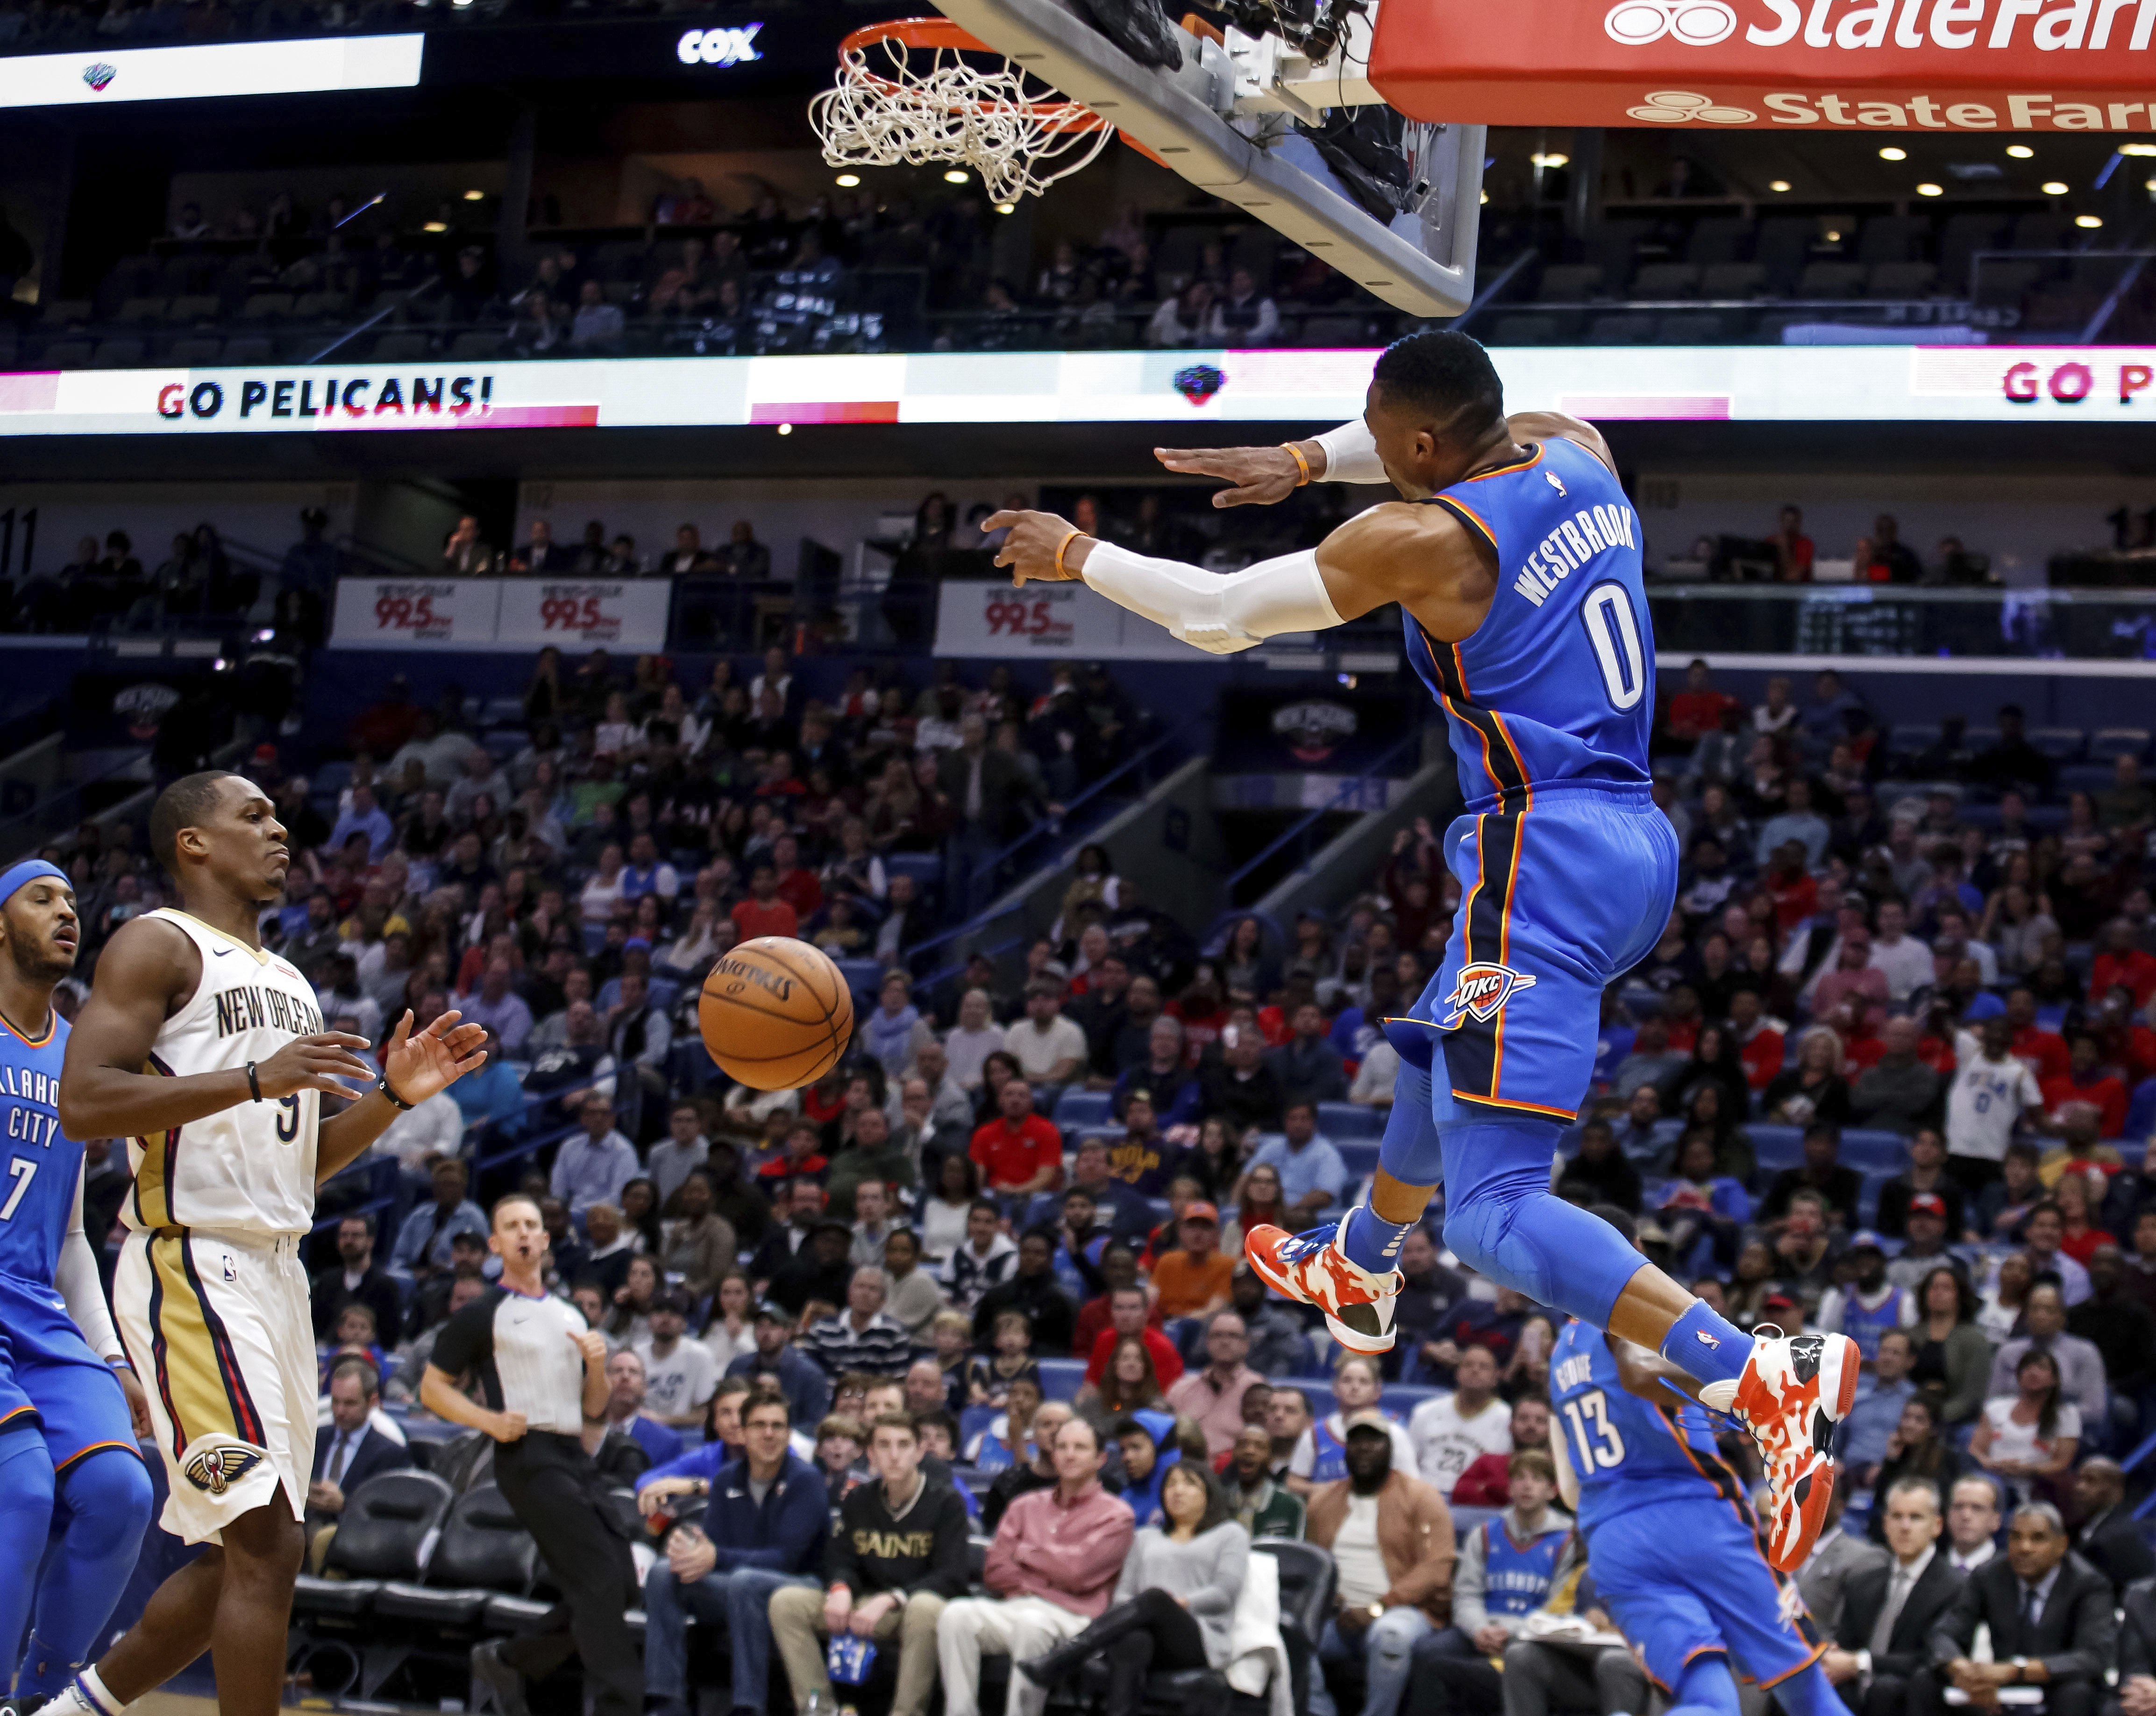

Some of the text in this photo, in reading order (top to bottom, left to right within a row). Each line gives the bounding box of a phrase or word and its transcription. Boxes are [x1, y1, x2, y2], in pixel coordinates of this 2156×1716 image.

[677, 22, 763, 68] COX
[1763, 93, 2156, 130] State Far
[157, 376, 494, 420] GO PELICANS!
[2003, 362, 2094, 404] GO
[1513, 503, 1635, 607] WESTBROOK
[1581, 580, 1645, 712] 0
[214, 986, 264, 1039] NEW
[1457, 974, 1501, 1008] OKC
[0, 1064, 59, 1108] LAHO
[8, 1106, 60, 1149] CITY
[0, 1155, 39, 1221] 7
[1563, 1388, 1626, 1475] 13
